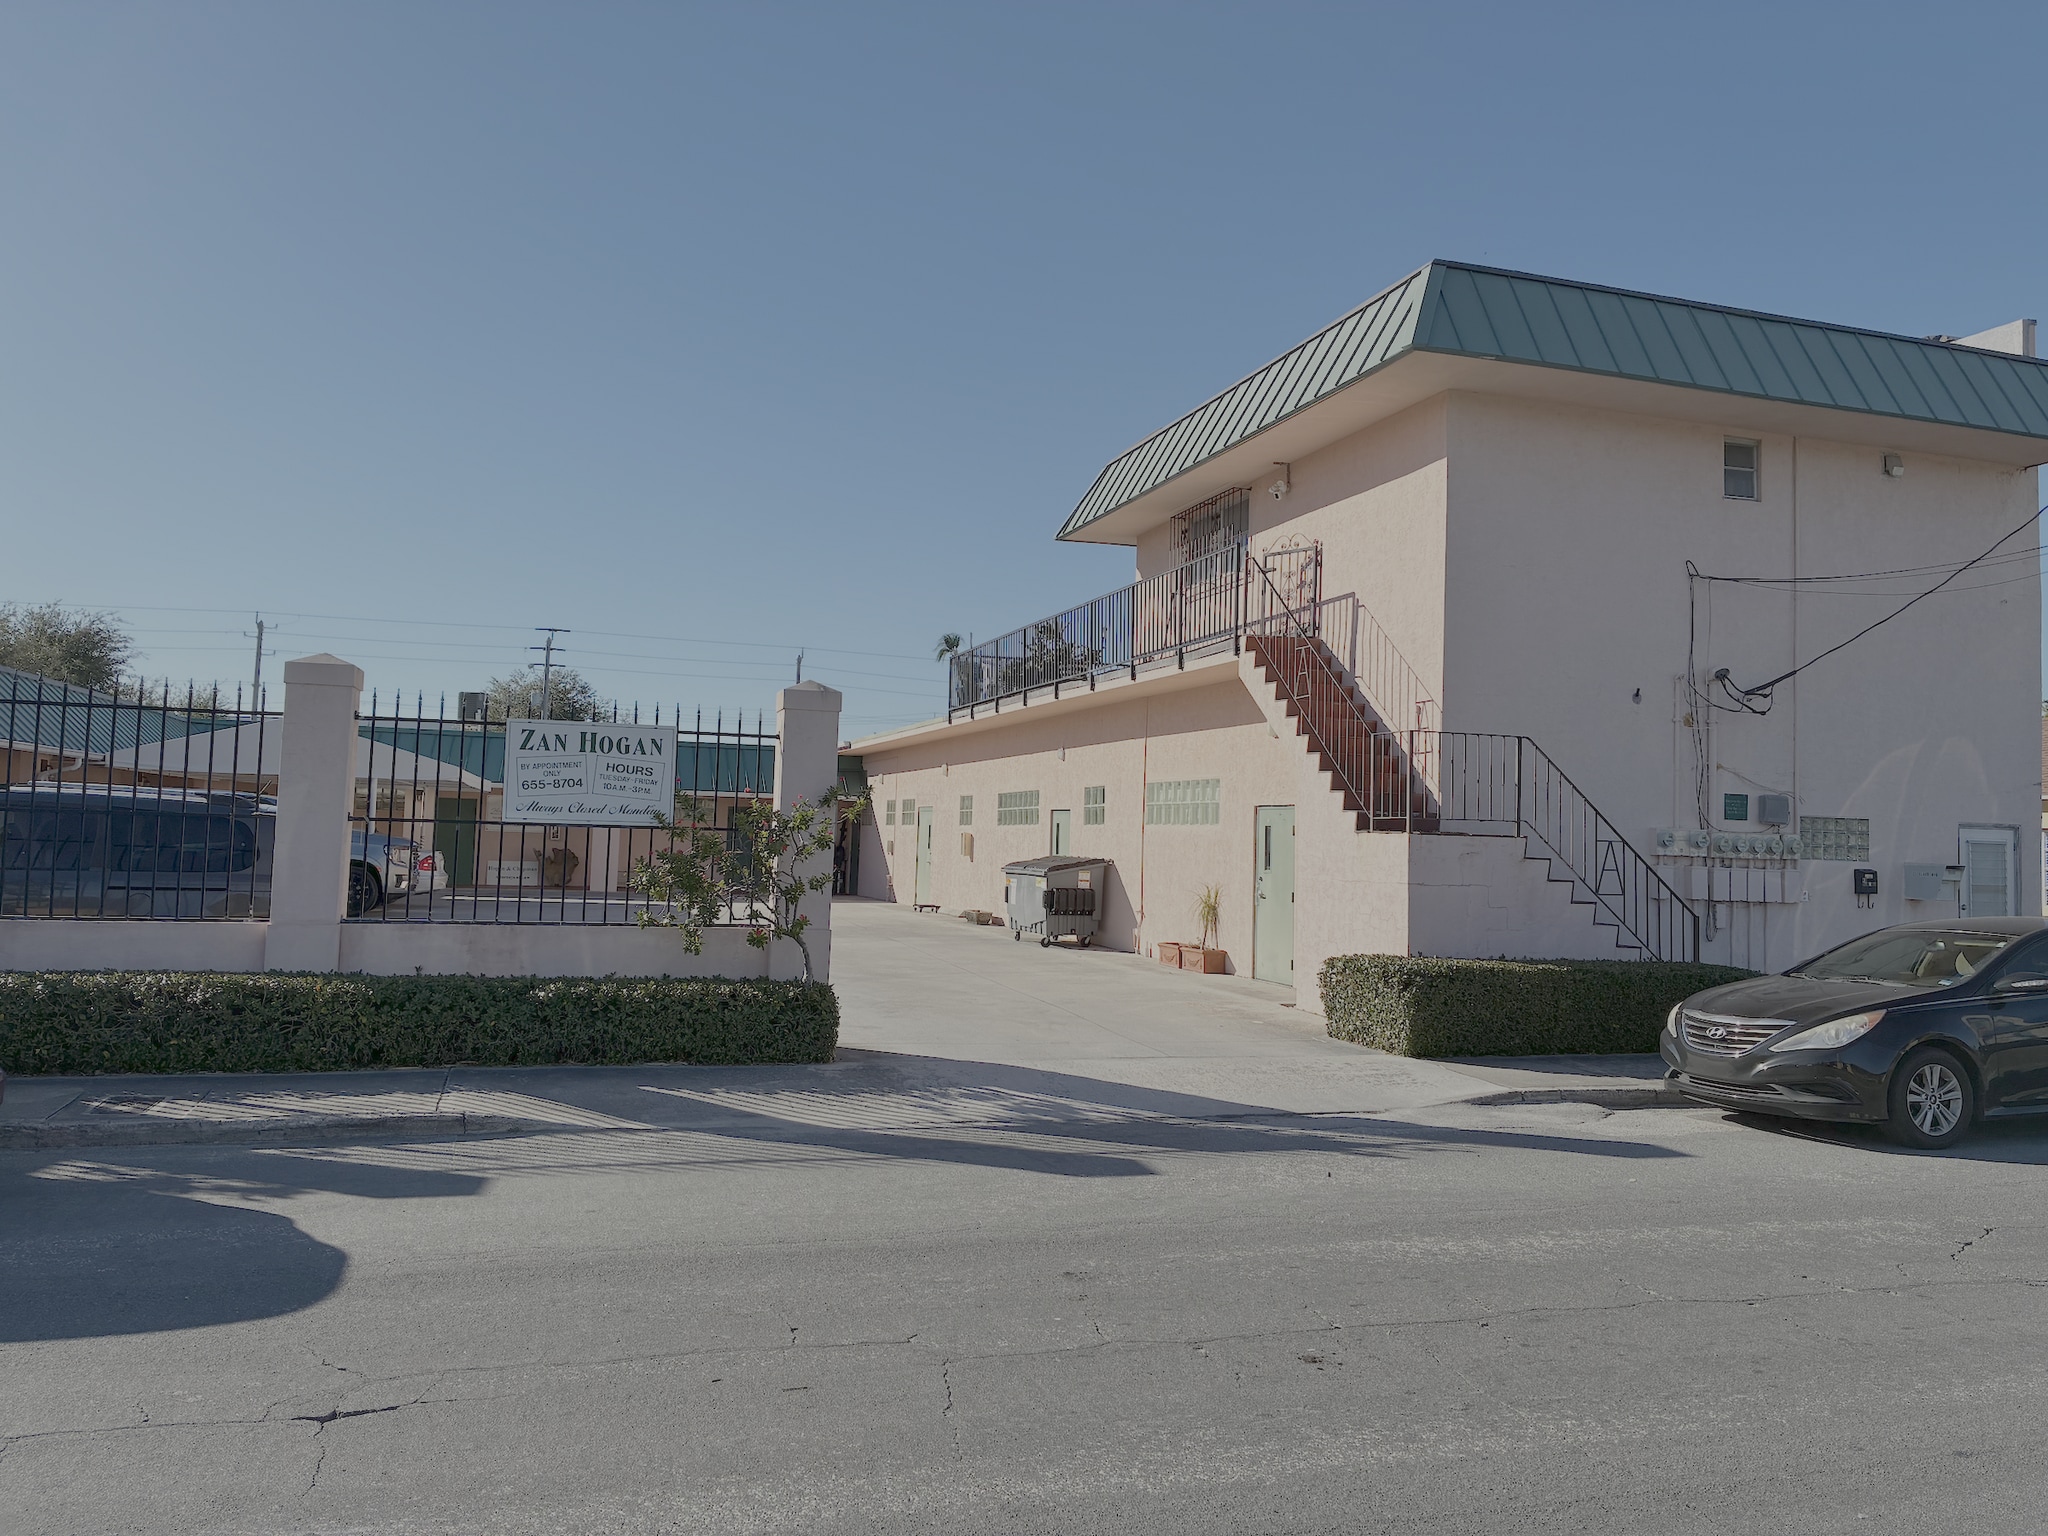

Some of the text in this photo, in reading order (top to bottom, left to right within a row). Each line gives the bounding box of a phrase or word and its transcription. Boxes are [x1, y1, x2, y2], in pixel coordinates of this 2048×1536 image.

[518, 728, 663, 756] ZAN HOGAN
[532, 761, 582, 770] APPOINTMENT
[605, 762, 654, 777] HOURS
[521, 778, 583, 790] 655-8704
[515, 800, 563, 815] Always
[568, 801, 608, 814] Closed
